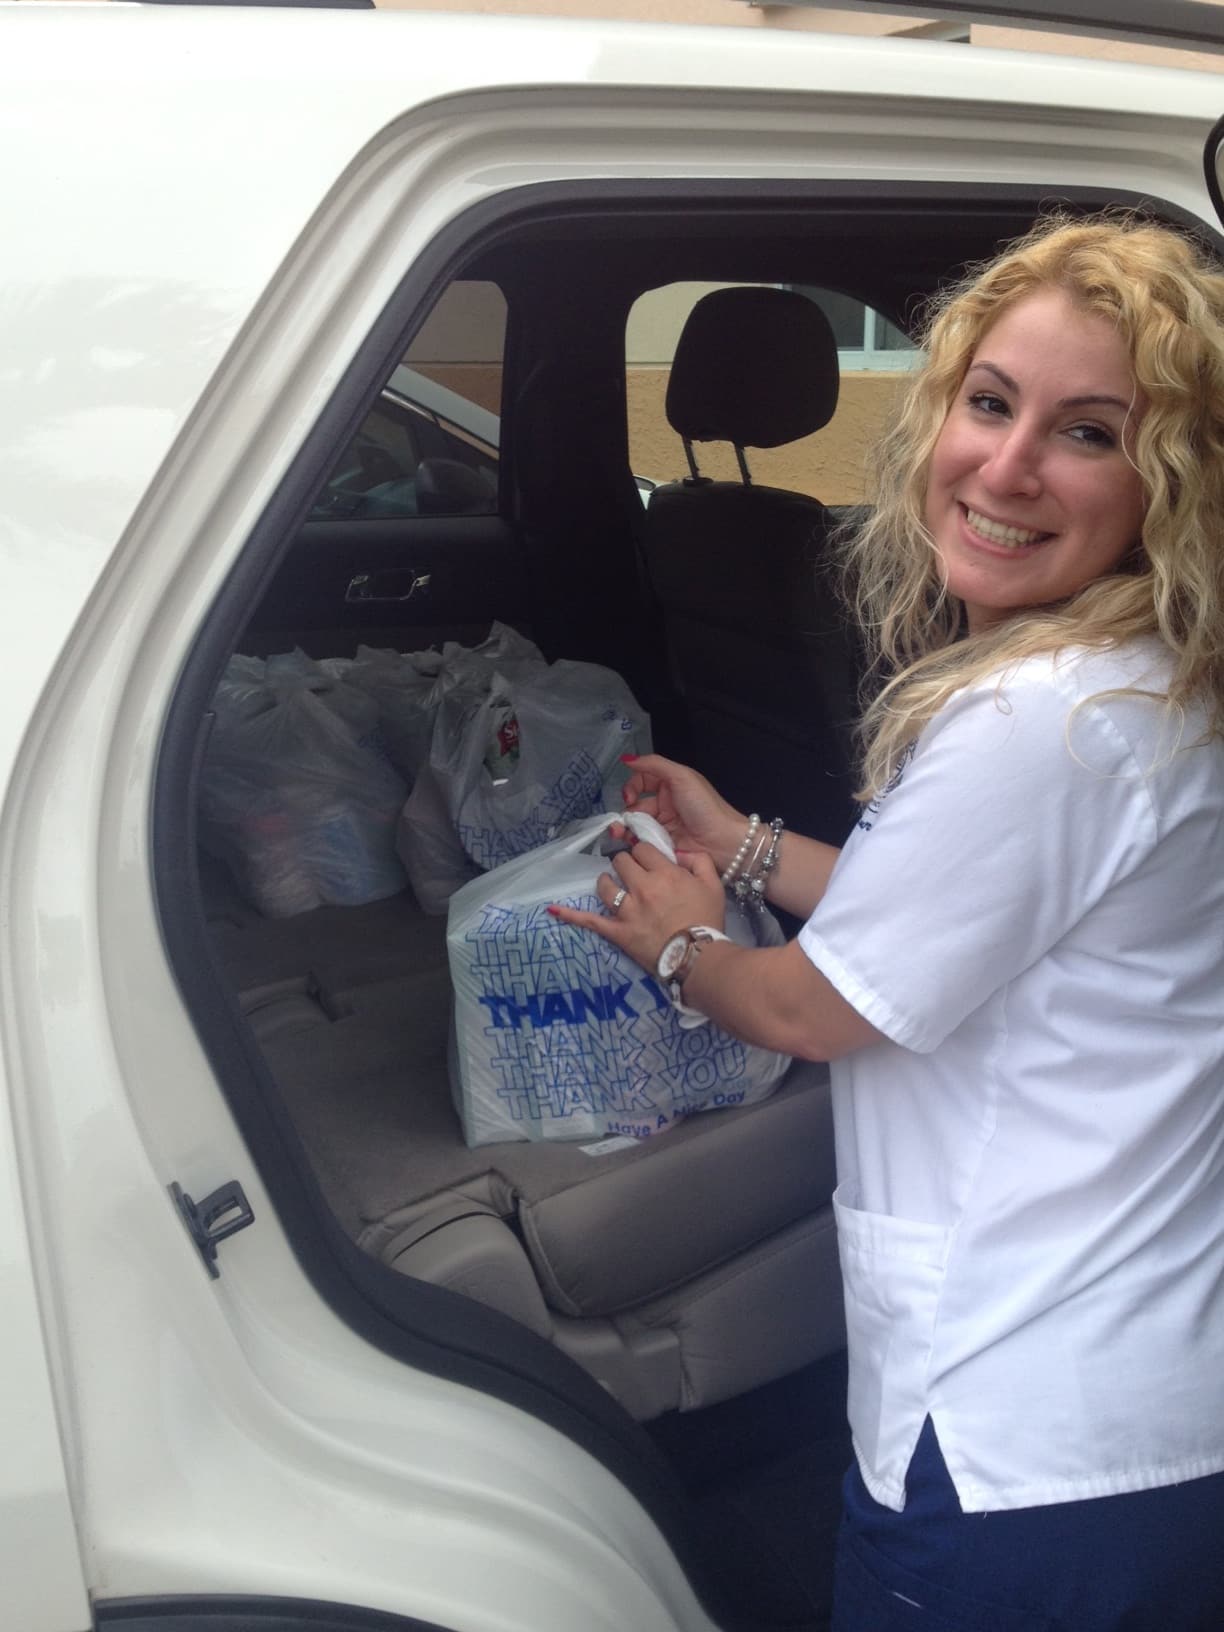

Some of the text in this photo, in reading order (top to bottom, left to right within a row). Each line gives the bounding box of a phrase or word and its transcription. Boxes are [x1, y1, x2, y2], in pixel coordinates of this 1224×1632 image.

[470, 950, 633, 998] THANK
[478, 980, 640, 1029] THANK
[484, 1014, 646, 1059] THANK
[491, 1044, 652, 1092] THANK
[497, 1042, 746, 1120] THANK YOU
[607, 1120, 652, 1138] Have
[656, 1113, 669, 1129] A
[713, 1090, 746, 1106] Day
